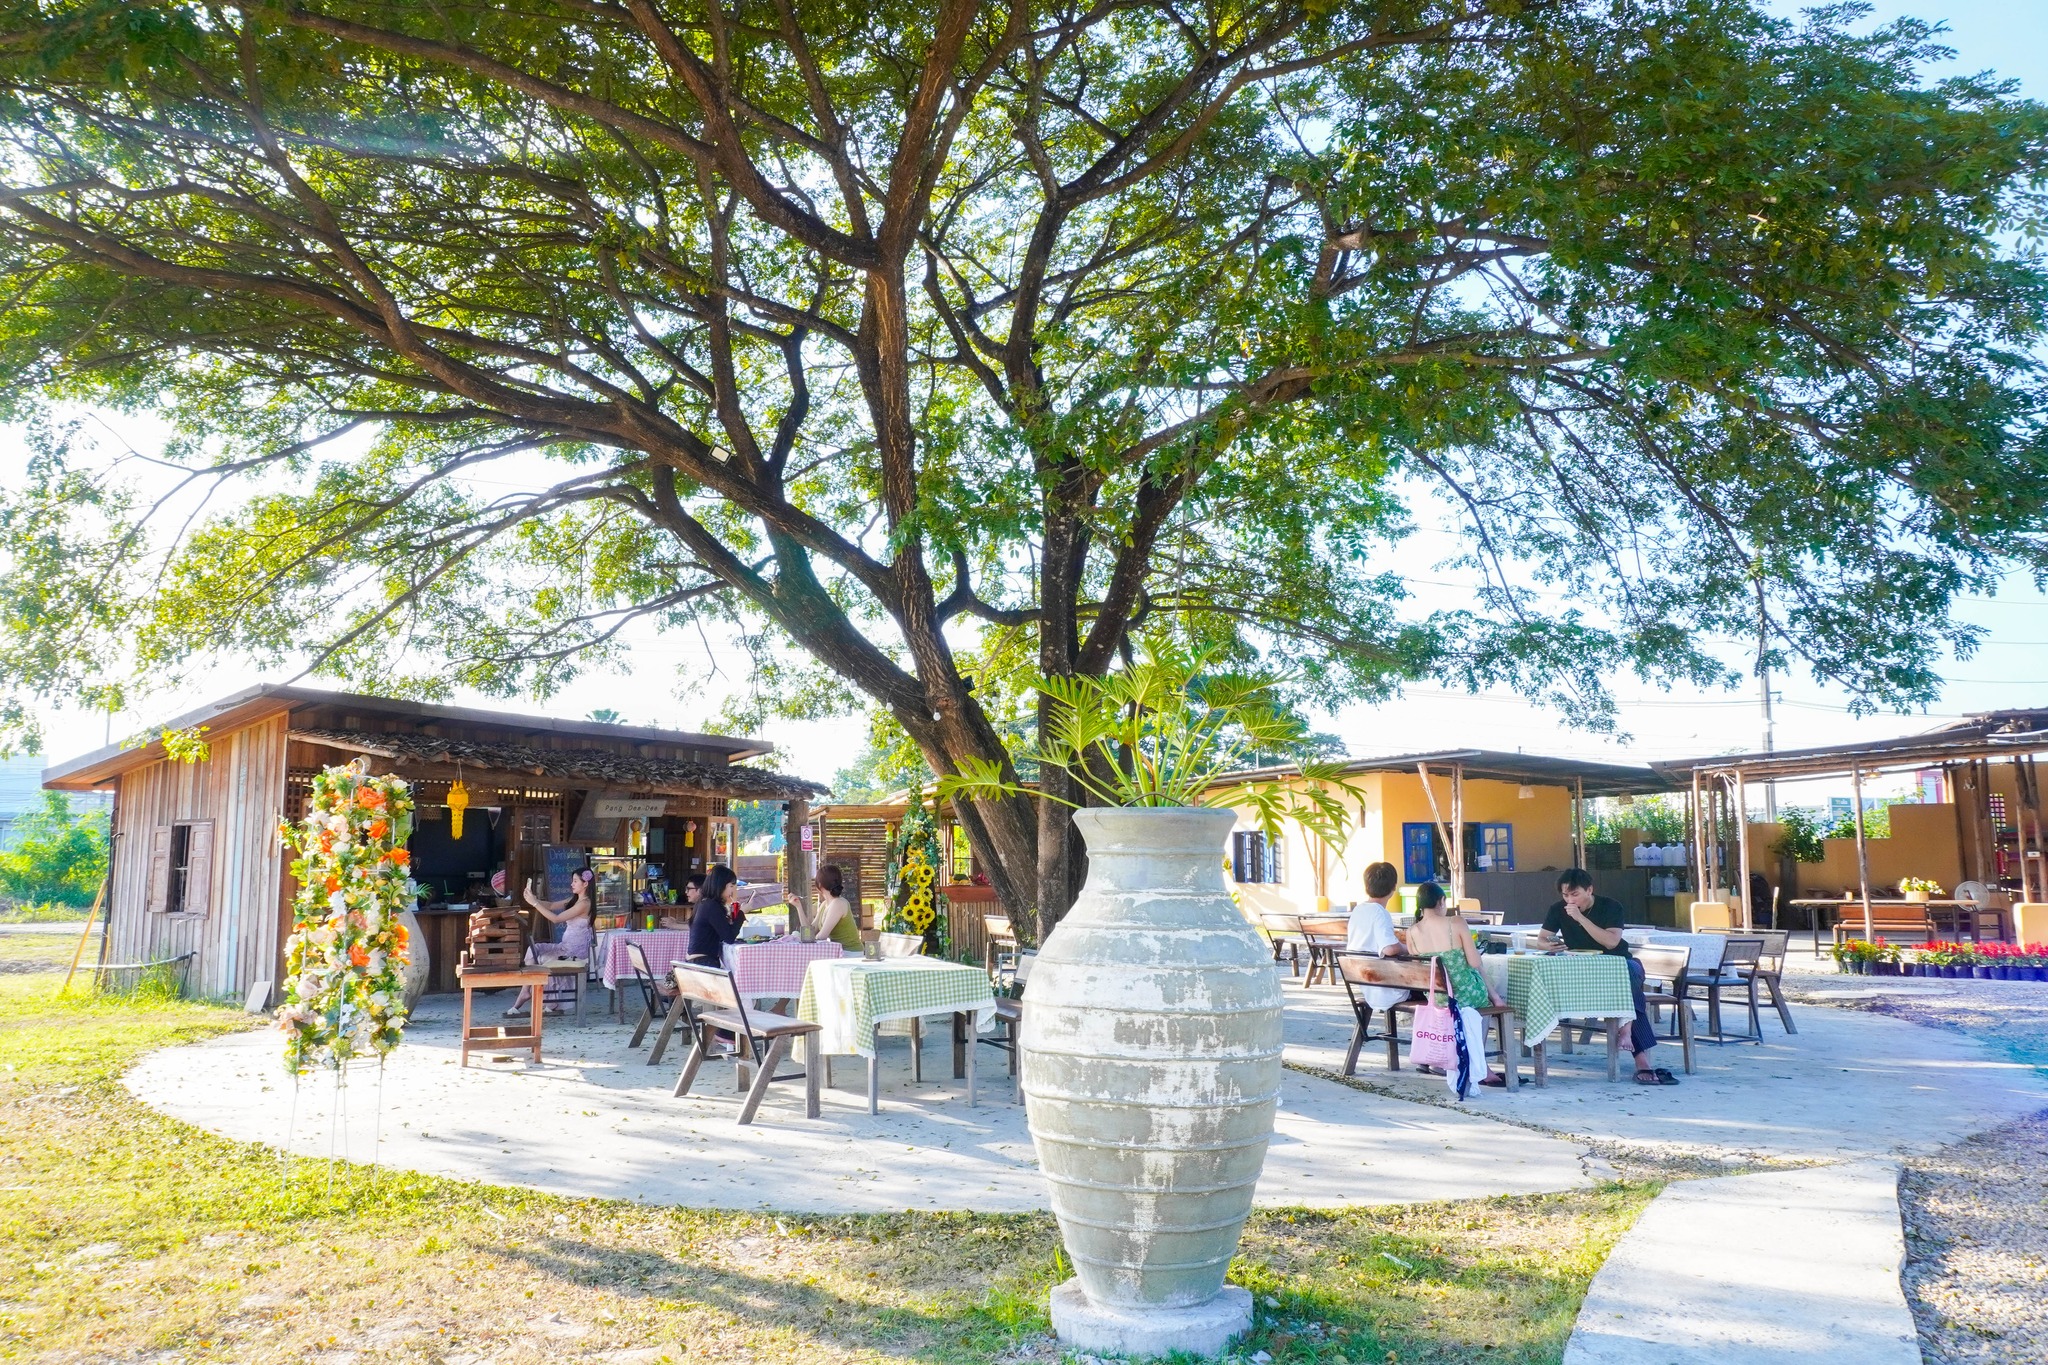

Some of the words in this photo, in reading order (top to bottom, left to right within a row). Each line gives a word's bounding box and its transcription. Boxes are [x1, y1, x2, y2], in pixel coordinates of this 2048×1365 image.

[604, 804, 623, 813] Pang
[868, 944, 876, 956] 3
[1416, 1030, 1456, 1043] GROCER
